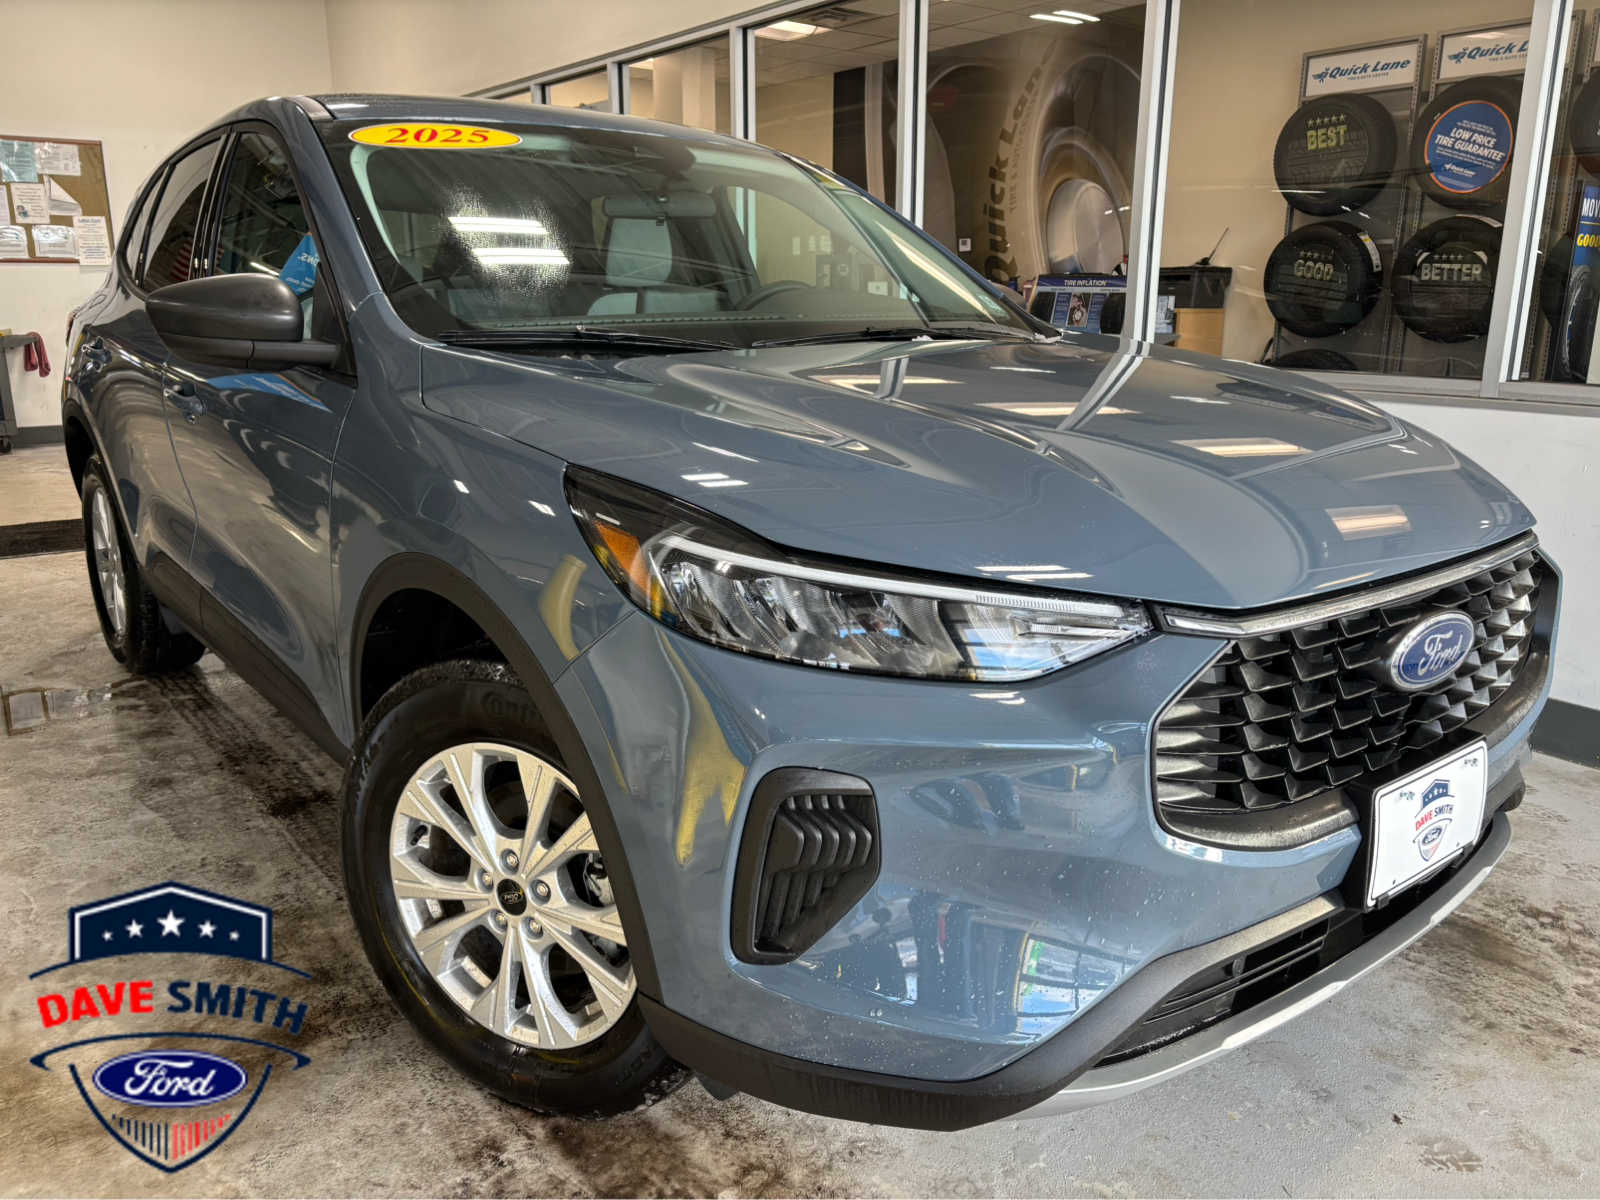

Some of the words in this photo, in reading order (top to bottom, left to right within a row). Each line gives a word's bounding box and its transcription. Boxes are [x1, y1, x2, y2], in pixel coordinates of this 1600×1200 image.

[1467, 42, 1516, 59] Quick
[1329, 62, 1370, 79] Quick
[1371, 60, 1411, 72] Lane
[386, 127, 491, 144] 2025
[1306, 125, 1348, 150] BEST
[1450, 128, 1472, 140] LOW
[1471, 133, 1496, 148] PRICE
[1435, 134, 1455, 147] TIRE
[1454, 140, 1505, 161] GUARANTEE
[1294, 259, 1334, 281] GOOD
[1421, 263, 1482, 281] BETTER
[1418, 630, 1464, 676] Ford
[1416, 810, 1433, 831] DAVE
[1434, 804, 1454, 817] SMITH
